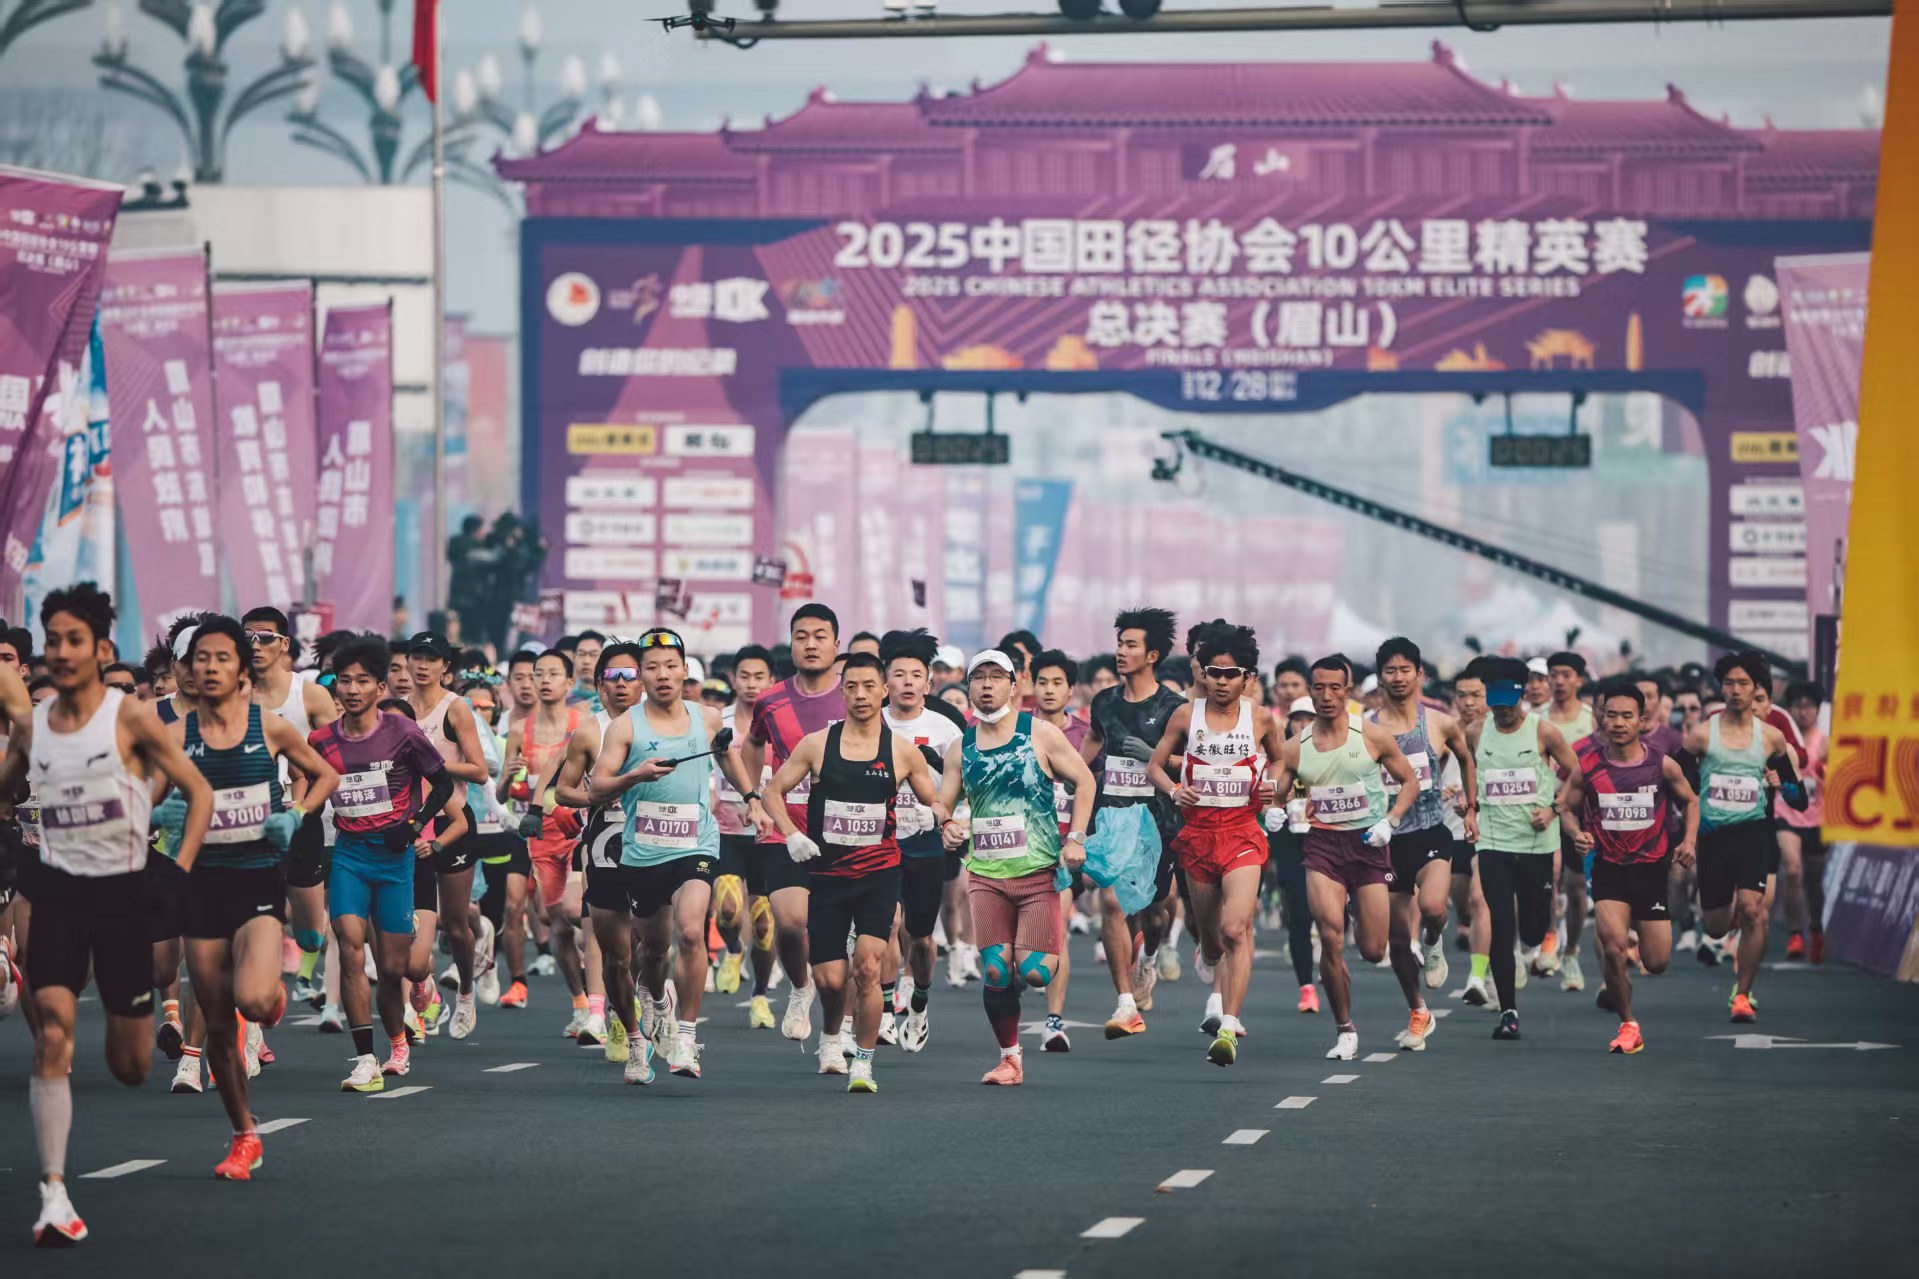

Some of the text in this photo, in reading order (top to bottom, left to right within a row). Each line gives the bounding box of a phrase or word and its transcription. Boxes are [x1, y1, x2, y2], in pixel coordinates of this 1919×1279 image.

[834, 217, 1648, 274] 2025中国田径协会10公里精英赛
[902, 276, 960, 297] 2025
[964, 276, 1066, 297] CHINESE
[1069, 276, 1193, 298] ATHLETICS
[1198, 276, 1358, 298] ASSOCIATION
[1430, 276, 1493, 297] ELITE
[1499, 276, 1581, 298] SERIES
[1087, 301, 1397, 348] 总决赛（眉山）
[1110, 772, 1146, 785] A 1502
[1203, 781, 1242, 793] A 8101
[1715, 788, 1724, 799] A
[1320, 798, 1360, 811] A 2866
[210, 806, 264, 828] A 9010
[1607, 807, 1647, 819] A 7098
[644, 819, 689, 834] A 0170
[832, 818, 876, 833] A 1033
[980, 832, 1016, 847] A 0141
